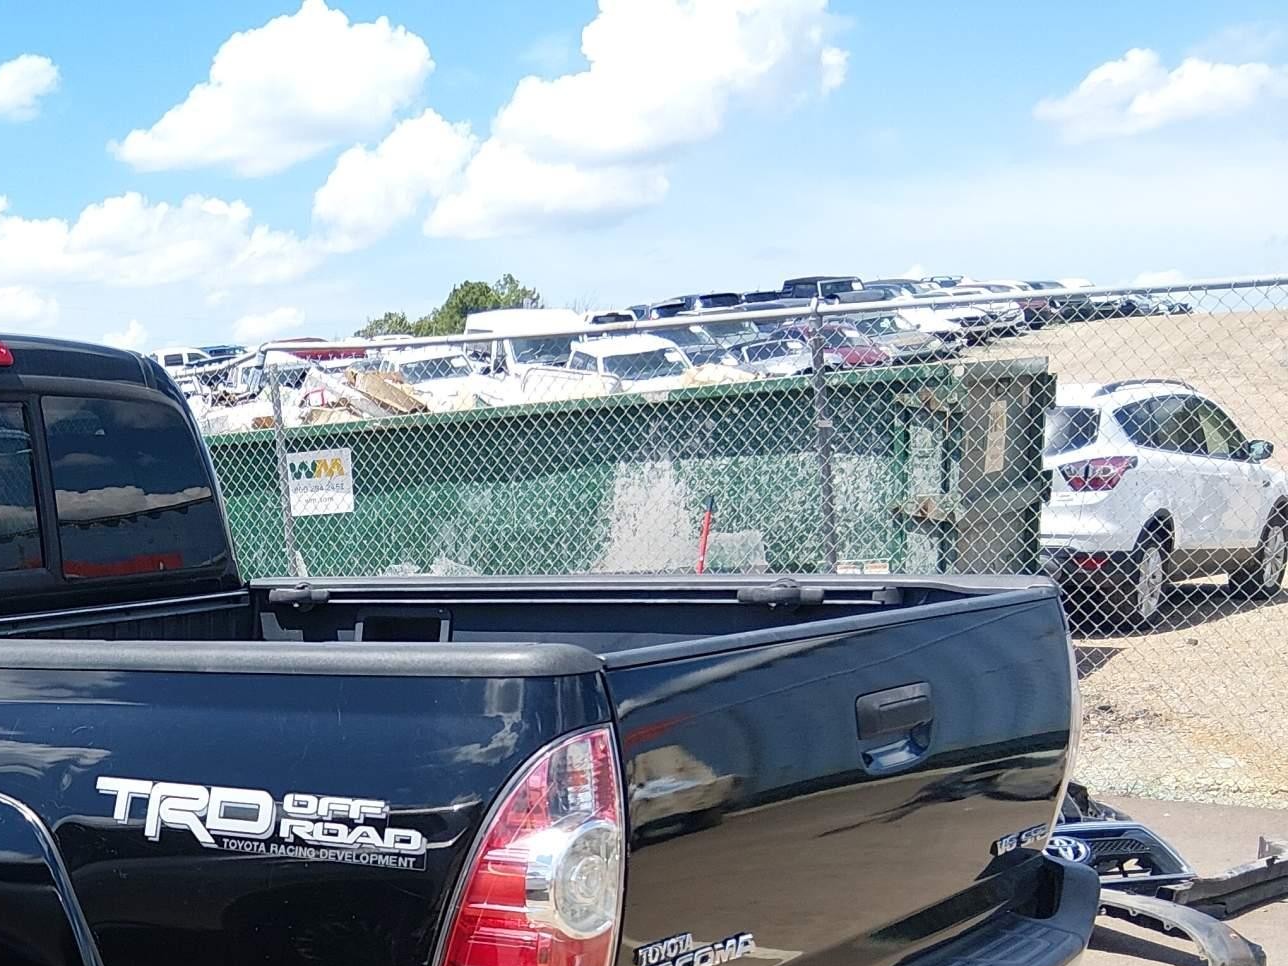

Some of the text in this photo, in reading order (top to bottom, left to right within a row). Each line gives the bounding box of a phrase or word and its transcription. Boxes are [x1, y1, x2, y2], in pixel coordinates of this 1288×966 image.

[289, 458, 345, 481] WM
[96, 776, 276, 848] TRD
[282, 792, 389, 820] OFF
[279, 818, 427, 855] ROAD
[996, 833, 1018, 857] V6
[222, 837, 417, 869] TOYOTA RACING DEVELOPMENT
